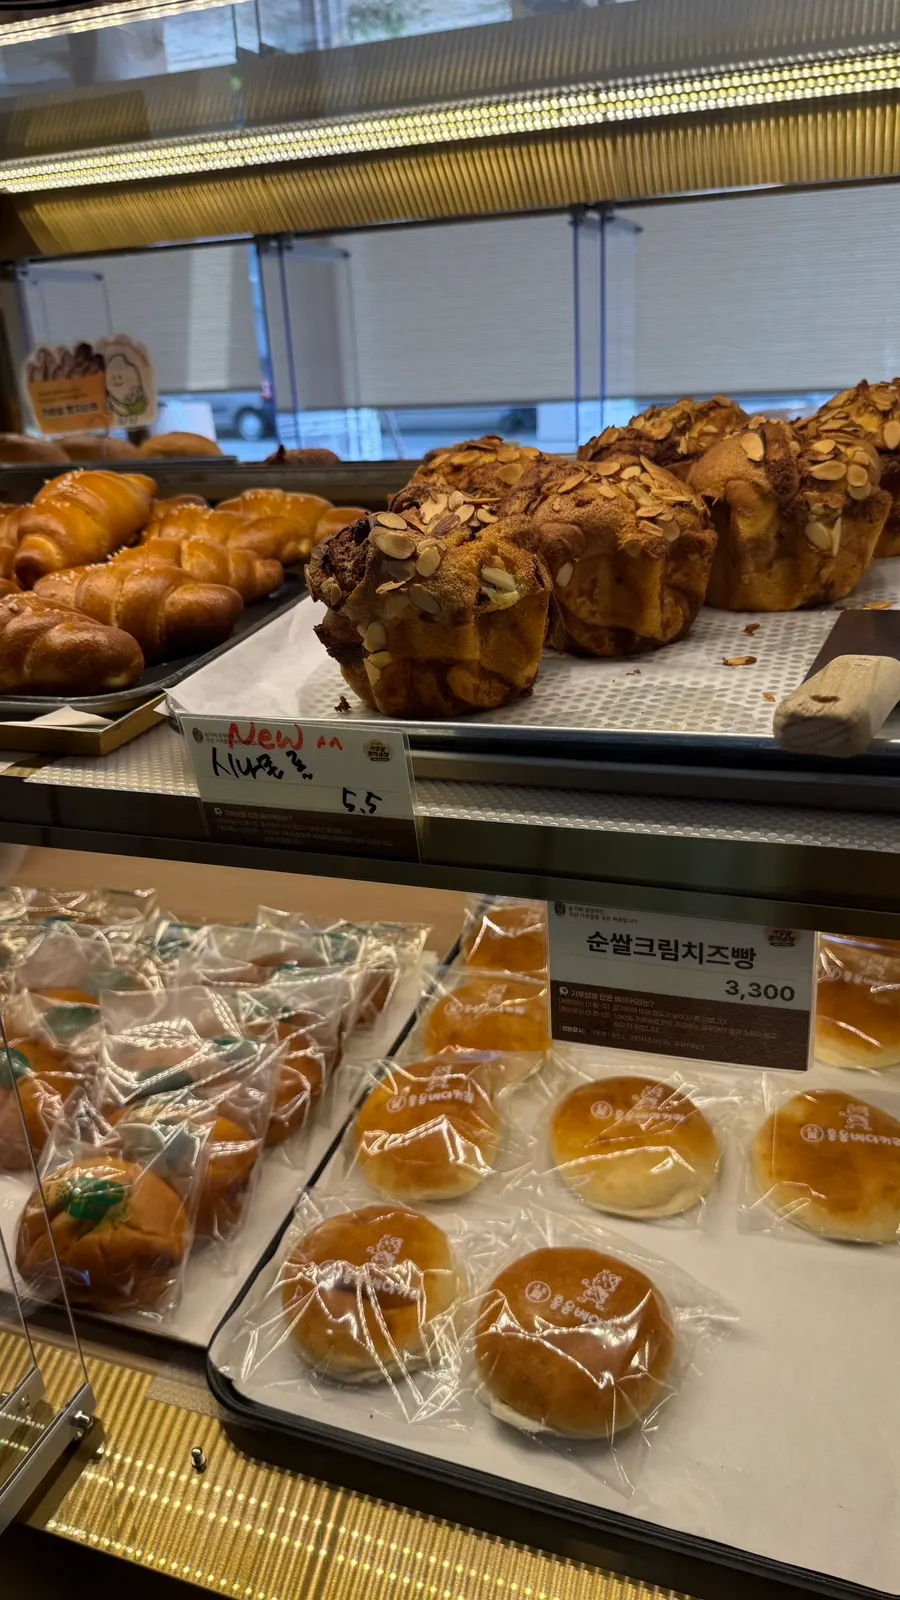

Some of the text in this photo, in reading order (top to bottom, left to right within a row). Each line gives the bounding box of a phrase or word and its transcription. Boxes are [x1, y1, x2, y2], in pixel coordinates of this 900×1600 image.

[228, 722, 304, 751] New
[342, 787, 382, 814] 5.5
[586, 930, 757, 970] 순쌀크림치즈빵
[725, 980, 796, 1002] 3,300
